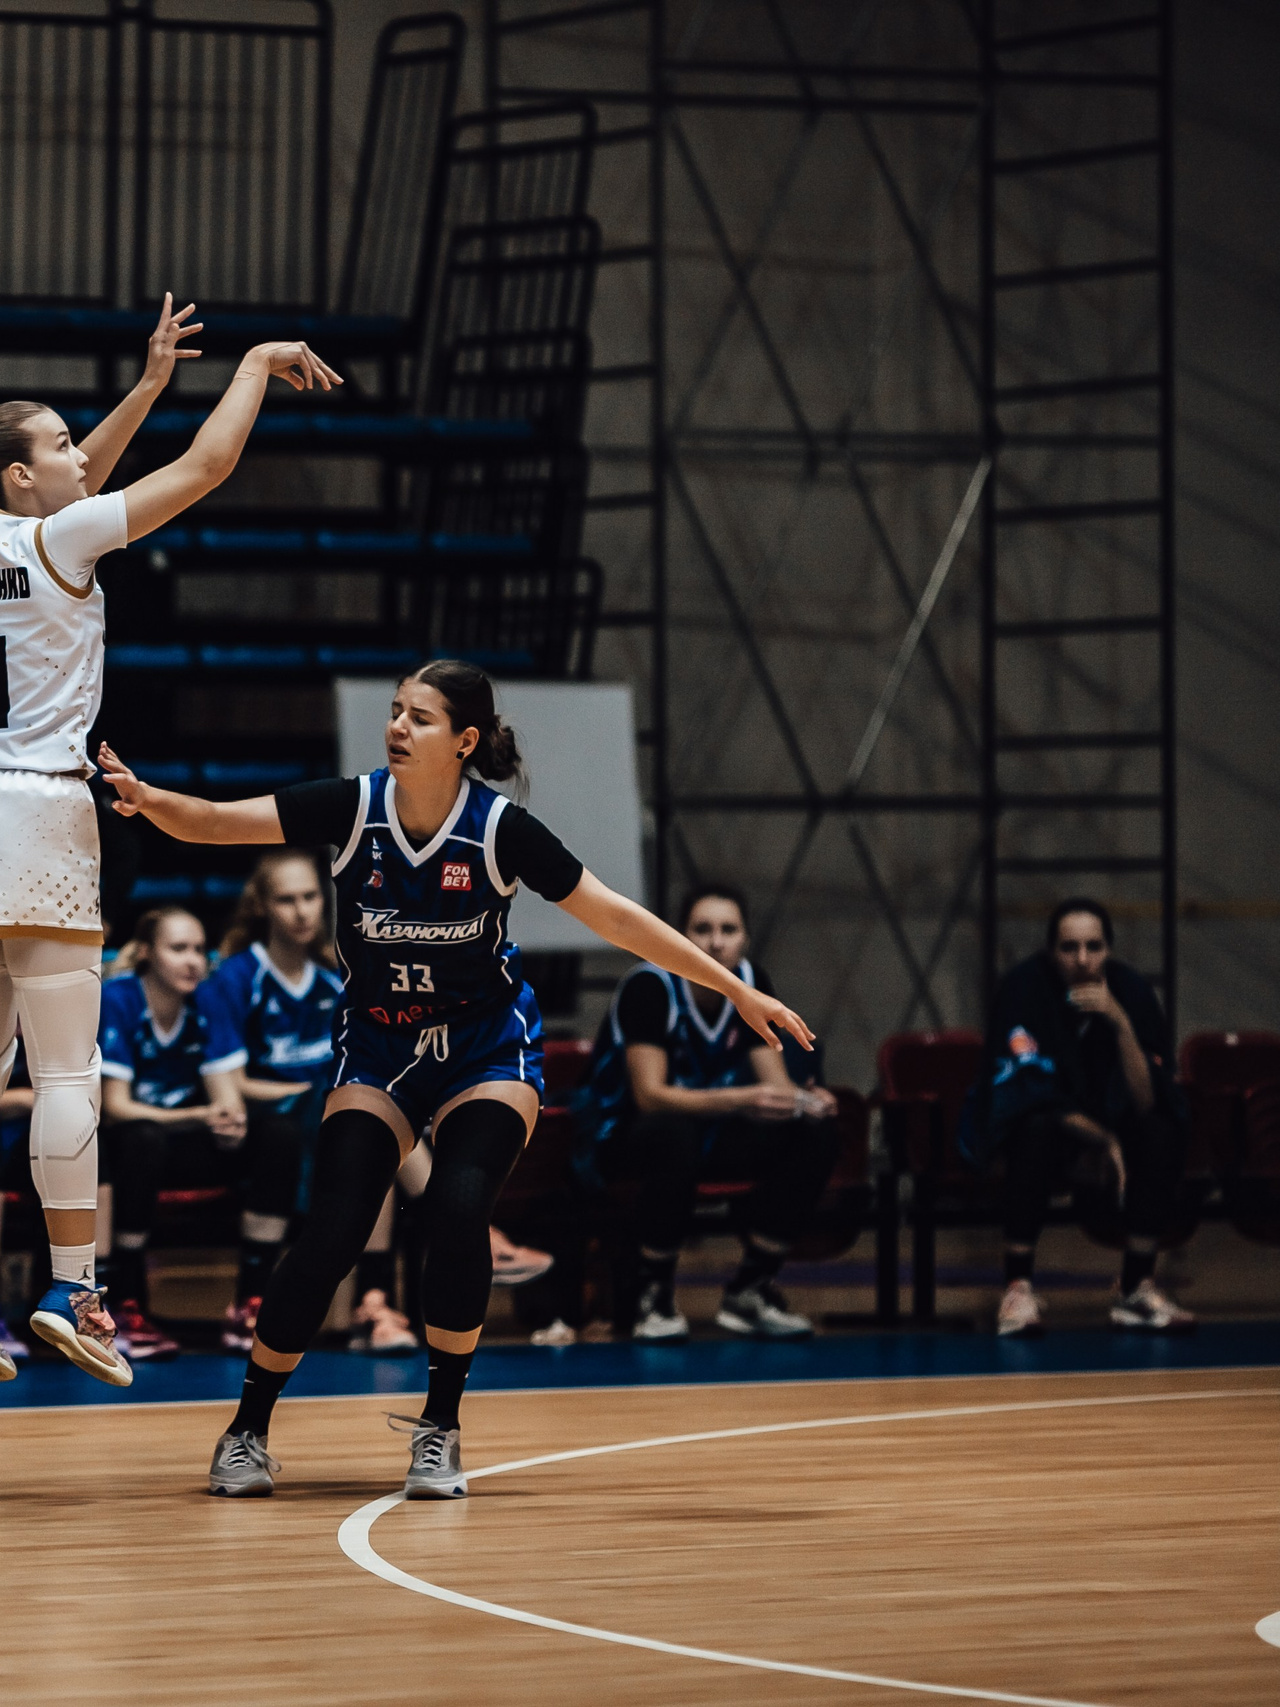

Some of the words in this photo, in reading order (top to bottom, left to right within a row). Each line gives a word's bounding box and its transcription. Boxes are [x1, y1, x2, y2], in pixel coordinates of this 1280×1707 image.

[444, 865, 470, 876] FON
[443, 876, 470, 887] BET
[390, 962, 435, 993] 33
